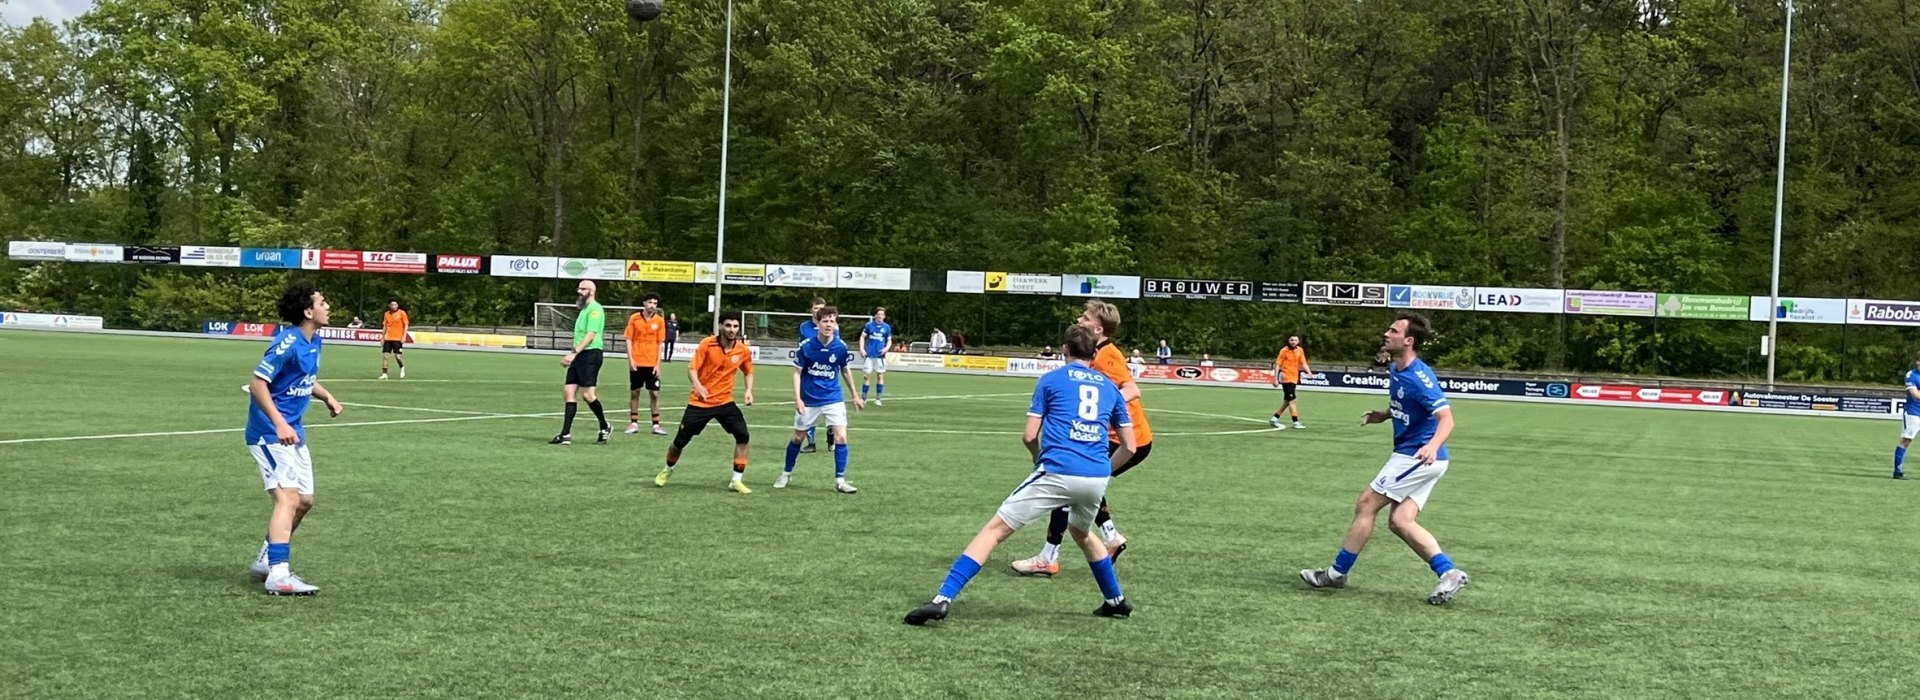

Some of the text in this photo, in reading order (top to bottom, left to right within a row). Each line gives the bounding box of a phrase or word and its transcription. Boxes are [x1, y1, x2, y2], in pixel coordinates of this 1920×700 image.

[370, 253, 393, 262] TLC
[439, 257, 478, 268] PALUX
[1147, 280, 1249, 295] BROUWER
[1021, 361, 1060, 372] Lift besch
[1342, 373, 1390, 389] Creating
[1449, 380, 1499, 392] together
[1078, 384, 1100, 421] 8
[1743, 391, 1800, 401] Autovakmeester
[1813, 395, 1839, 403] Soester
[1071, 419, 1099, 434] Your
[1069, 428, 1102, 442] lease
